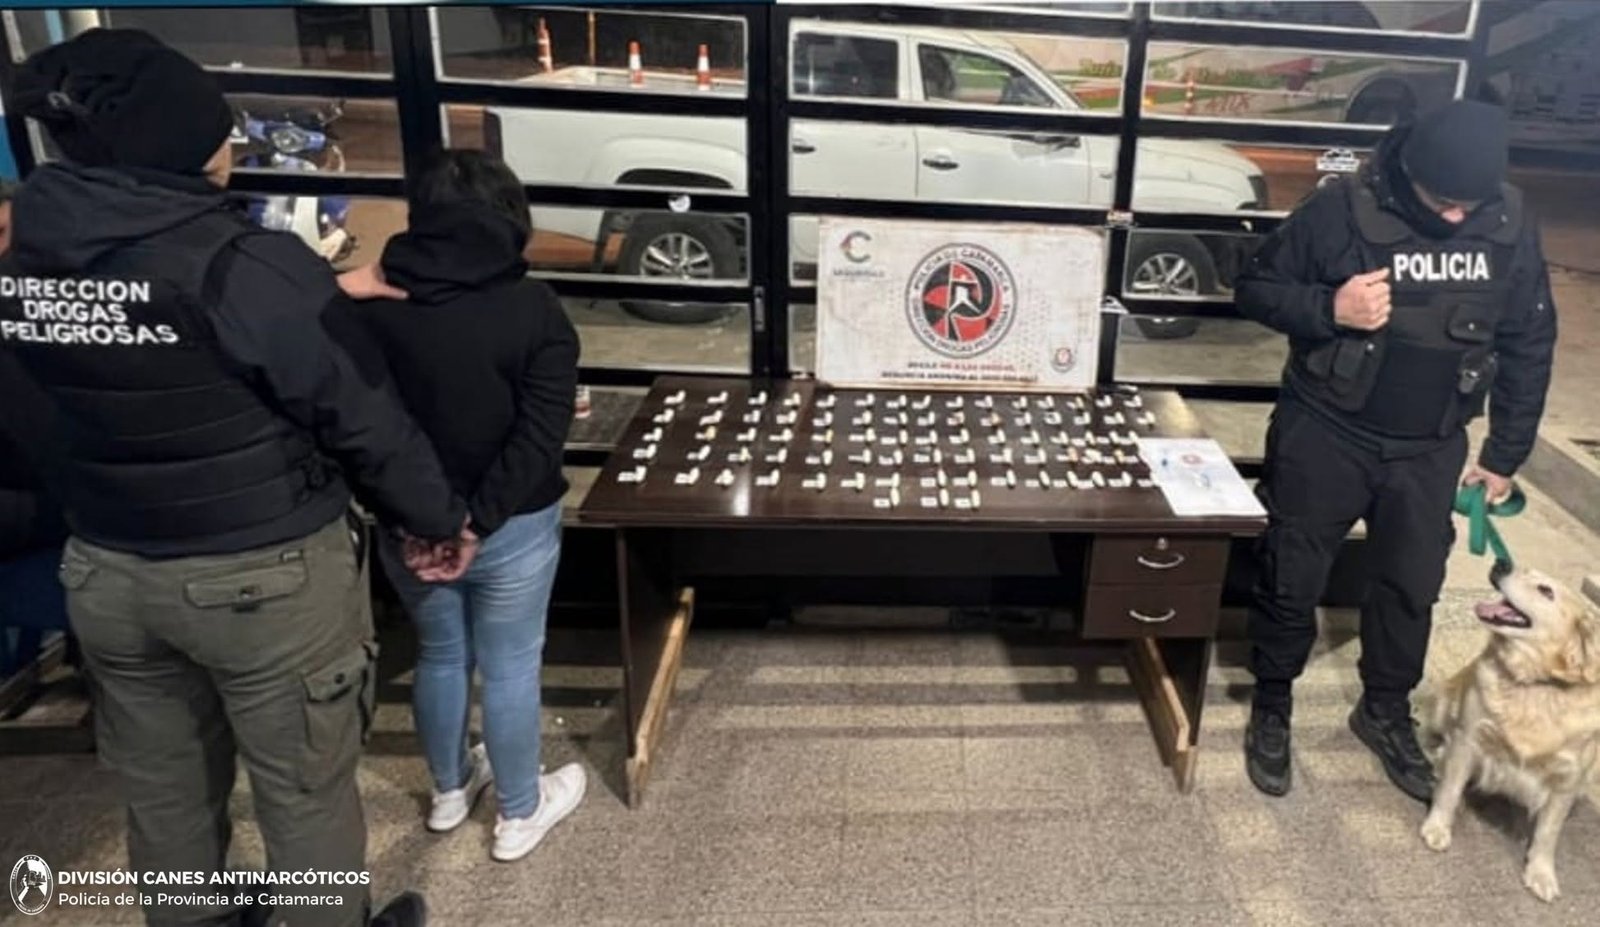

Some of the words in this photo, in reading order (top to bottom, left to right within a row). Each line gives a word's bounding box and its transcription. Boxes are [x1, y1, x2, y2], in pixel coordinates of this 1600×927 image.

[1393, 252, 1490, 281] POLICIA
[1, 276, 150, 302] DIRECCION
[23, 300, 127, 323] DROGAS
[1, 320, 179, 344] PELIGROSAS
